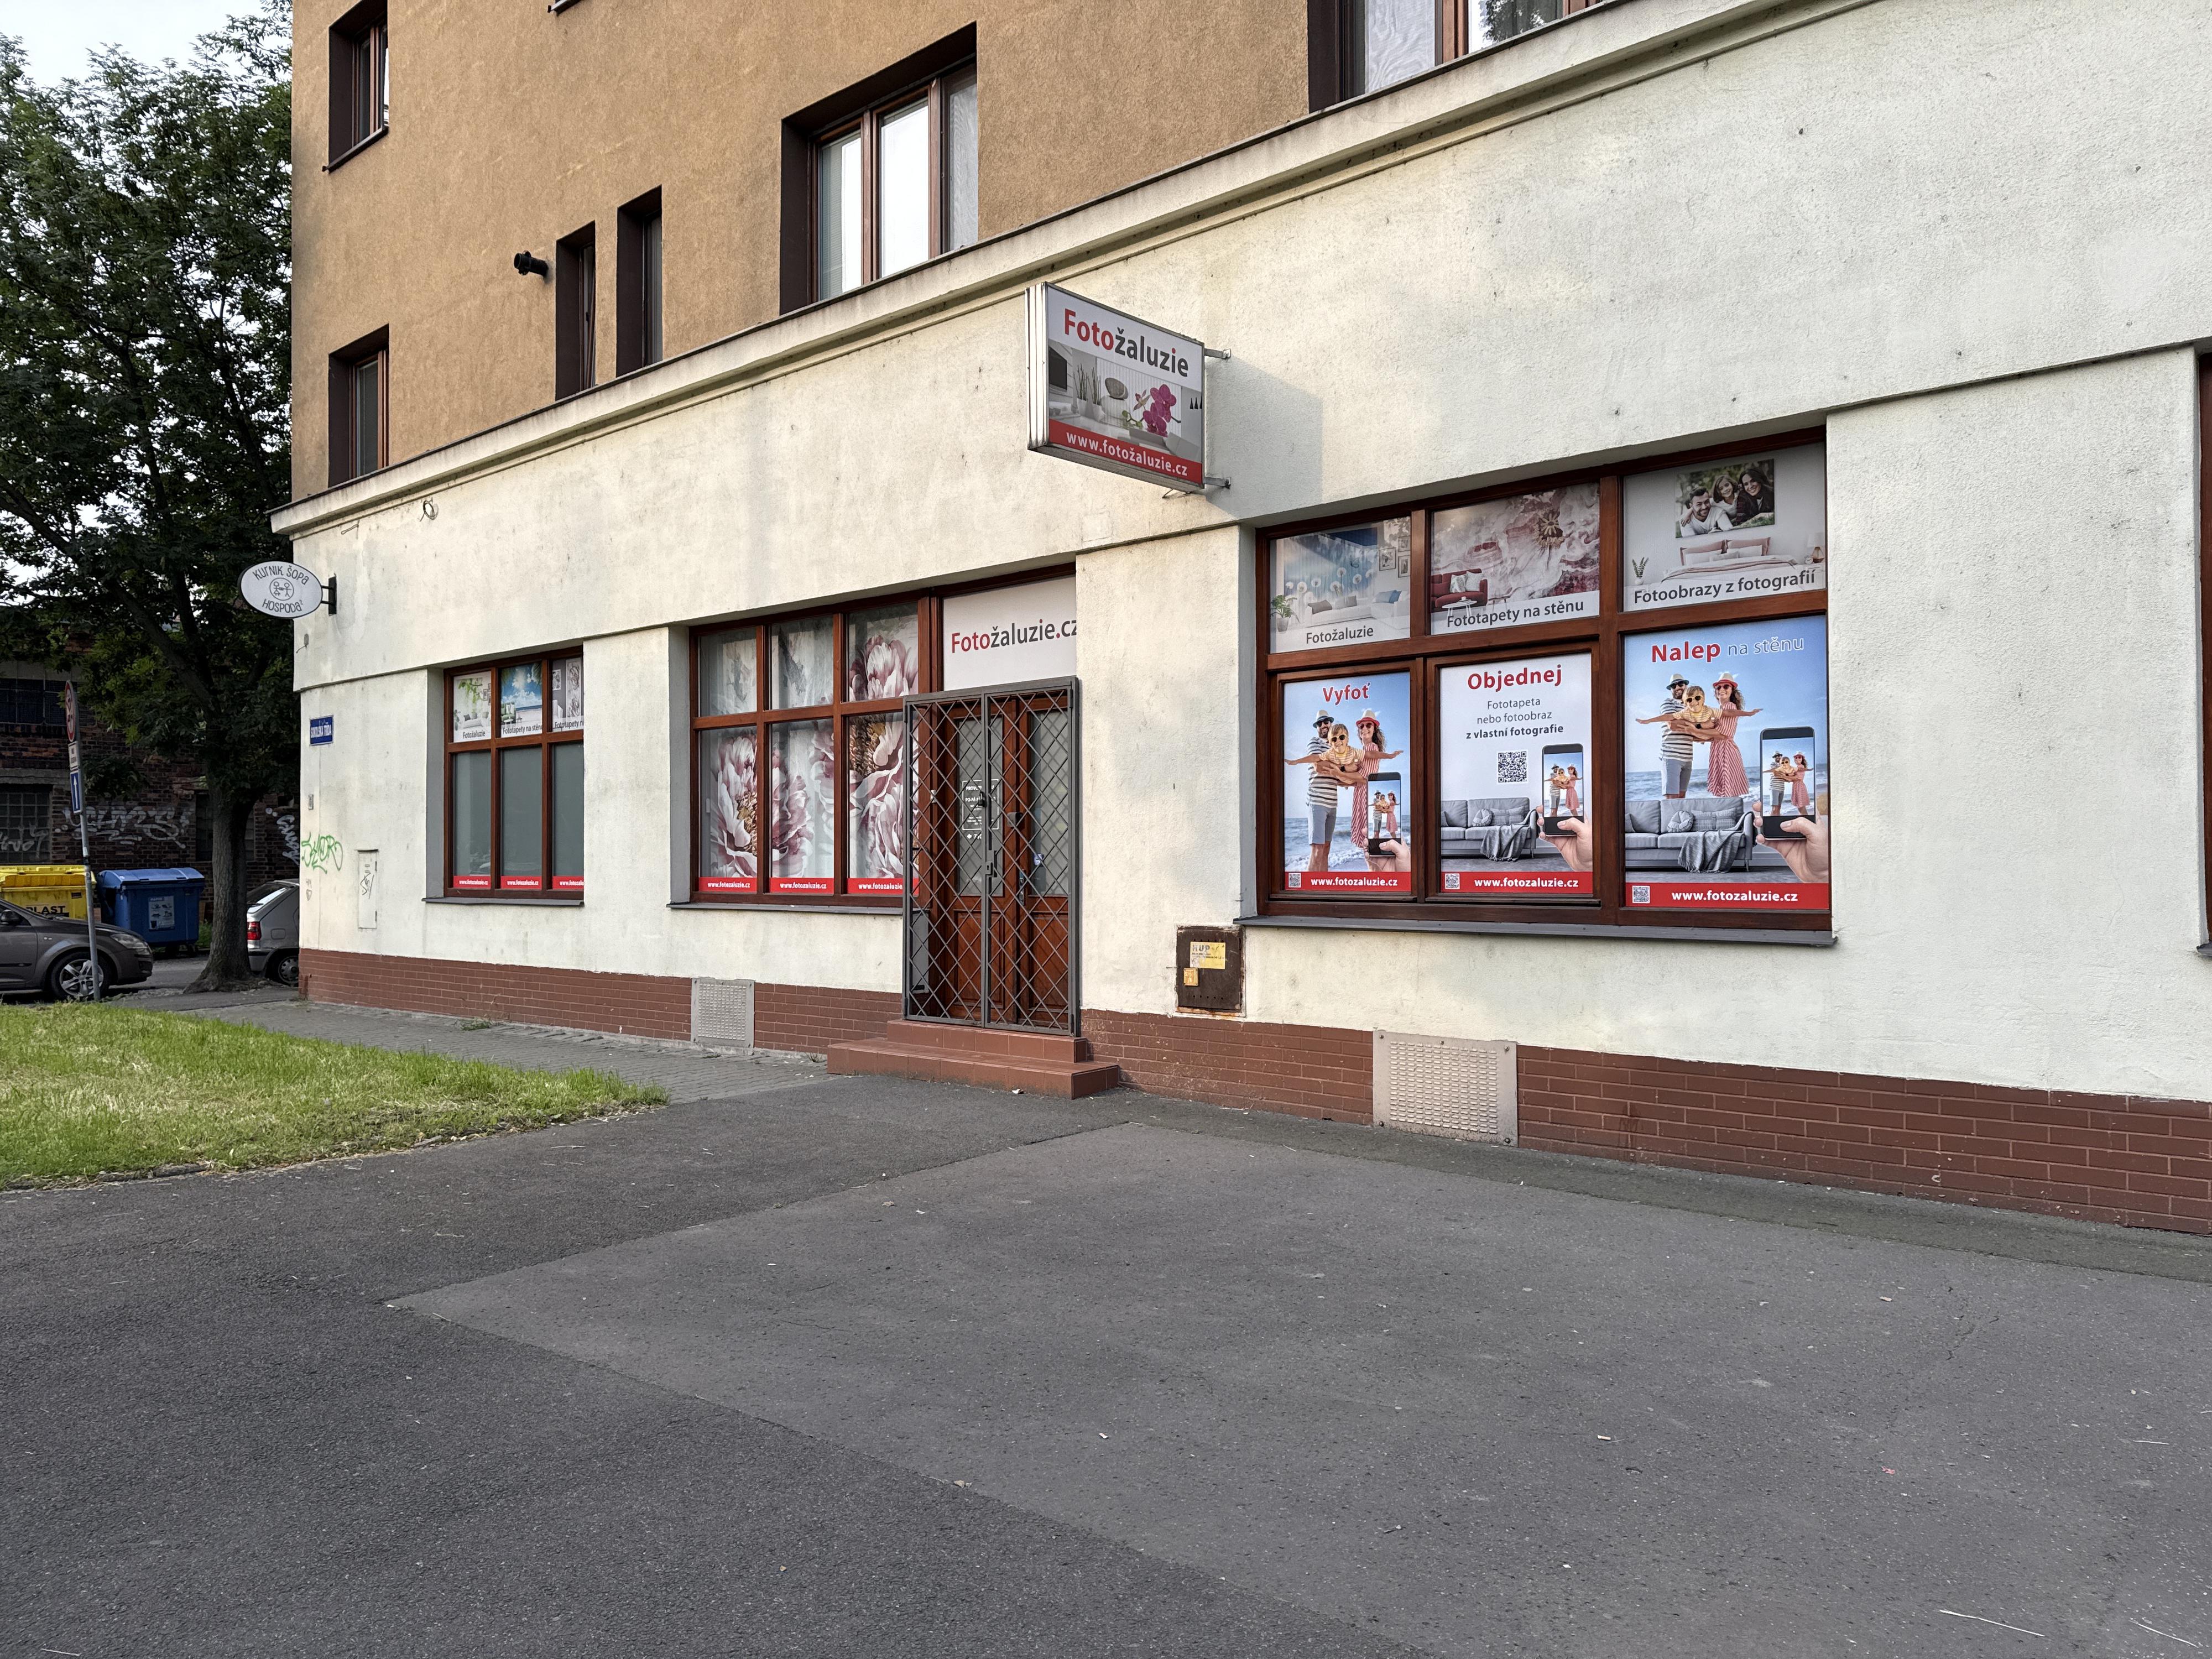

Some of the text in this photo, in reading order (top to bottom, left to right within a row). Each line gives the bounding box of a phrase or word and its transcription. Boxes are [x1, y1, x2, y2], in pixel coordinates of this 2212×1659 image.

[1065, 308, 1188, 377] Fotožaluzie
[1067, 431, 1187, 476] www.fotožaluzie.cz
[1635, 569, 1816, 603] Fotoobrazy z fotografií
[1447, 599, 1584, 628] Fototapety na stěnu
[952, 619, 1077, 654] Fotožaluzie.cz
[1306, 625, 1374, 644] Fotožaluzie
[1652, 637, 1804, 663] Nalep na stěnu
[1468, 664, 1562, 692] Objednej
[1322, 681, 1370, 706] Vyfoť
[1488, 698, 1541, 710] Fototapeta
[1477, 711, 1552, 724] nebo fotoobraz
[503, 725, 525, 735] Fototapety
[1474, 728, 1508, 738] vlastní
[1510, 724, 1564, 737] fotografie
[1311, 877, 1398, 886] www.fotozaluzie.cz
[1474, 878, 1579, 888] www.fotozaluzie.cz
[1671, 890, 1798, 901] www.fotozaluzie.cz
